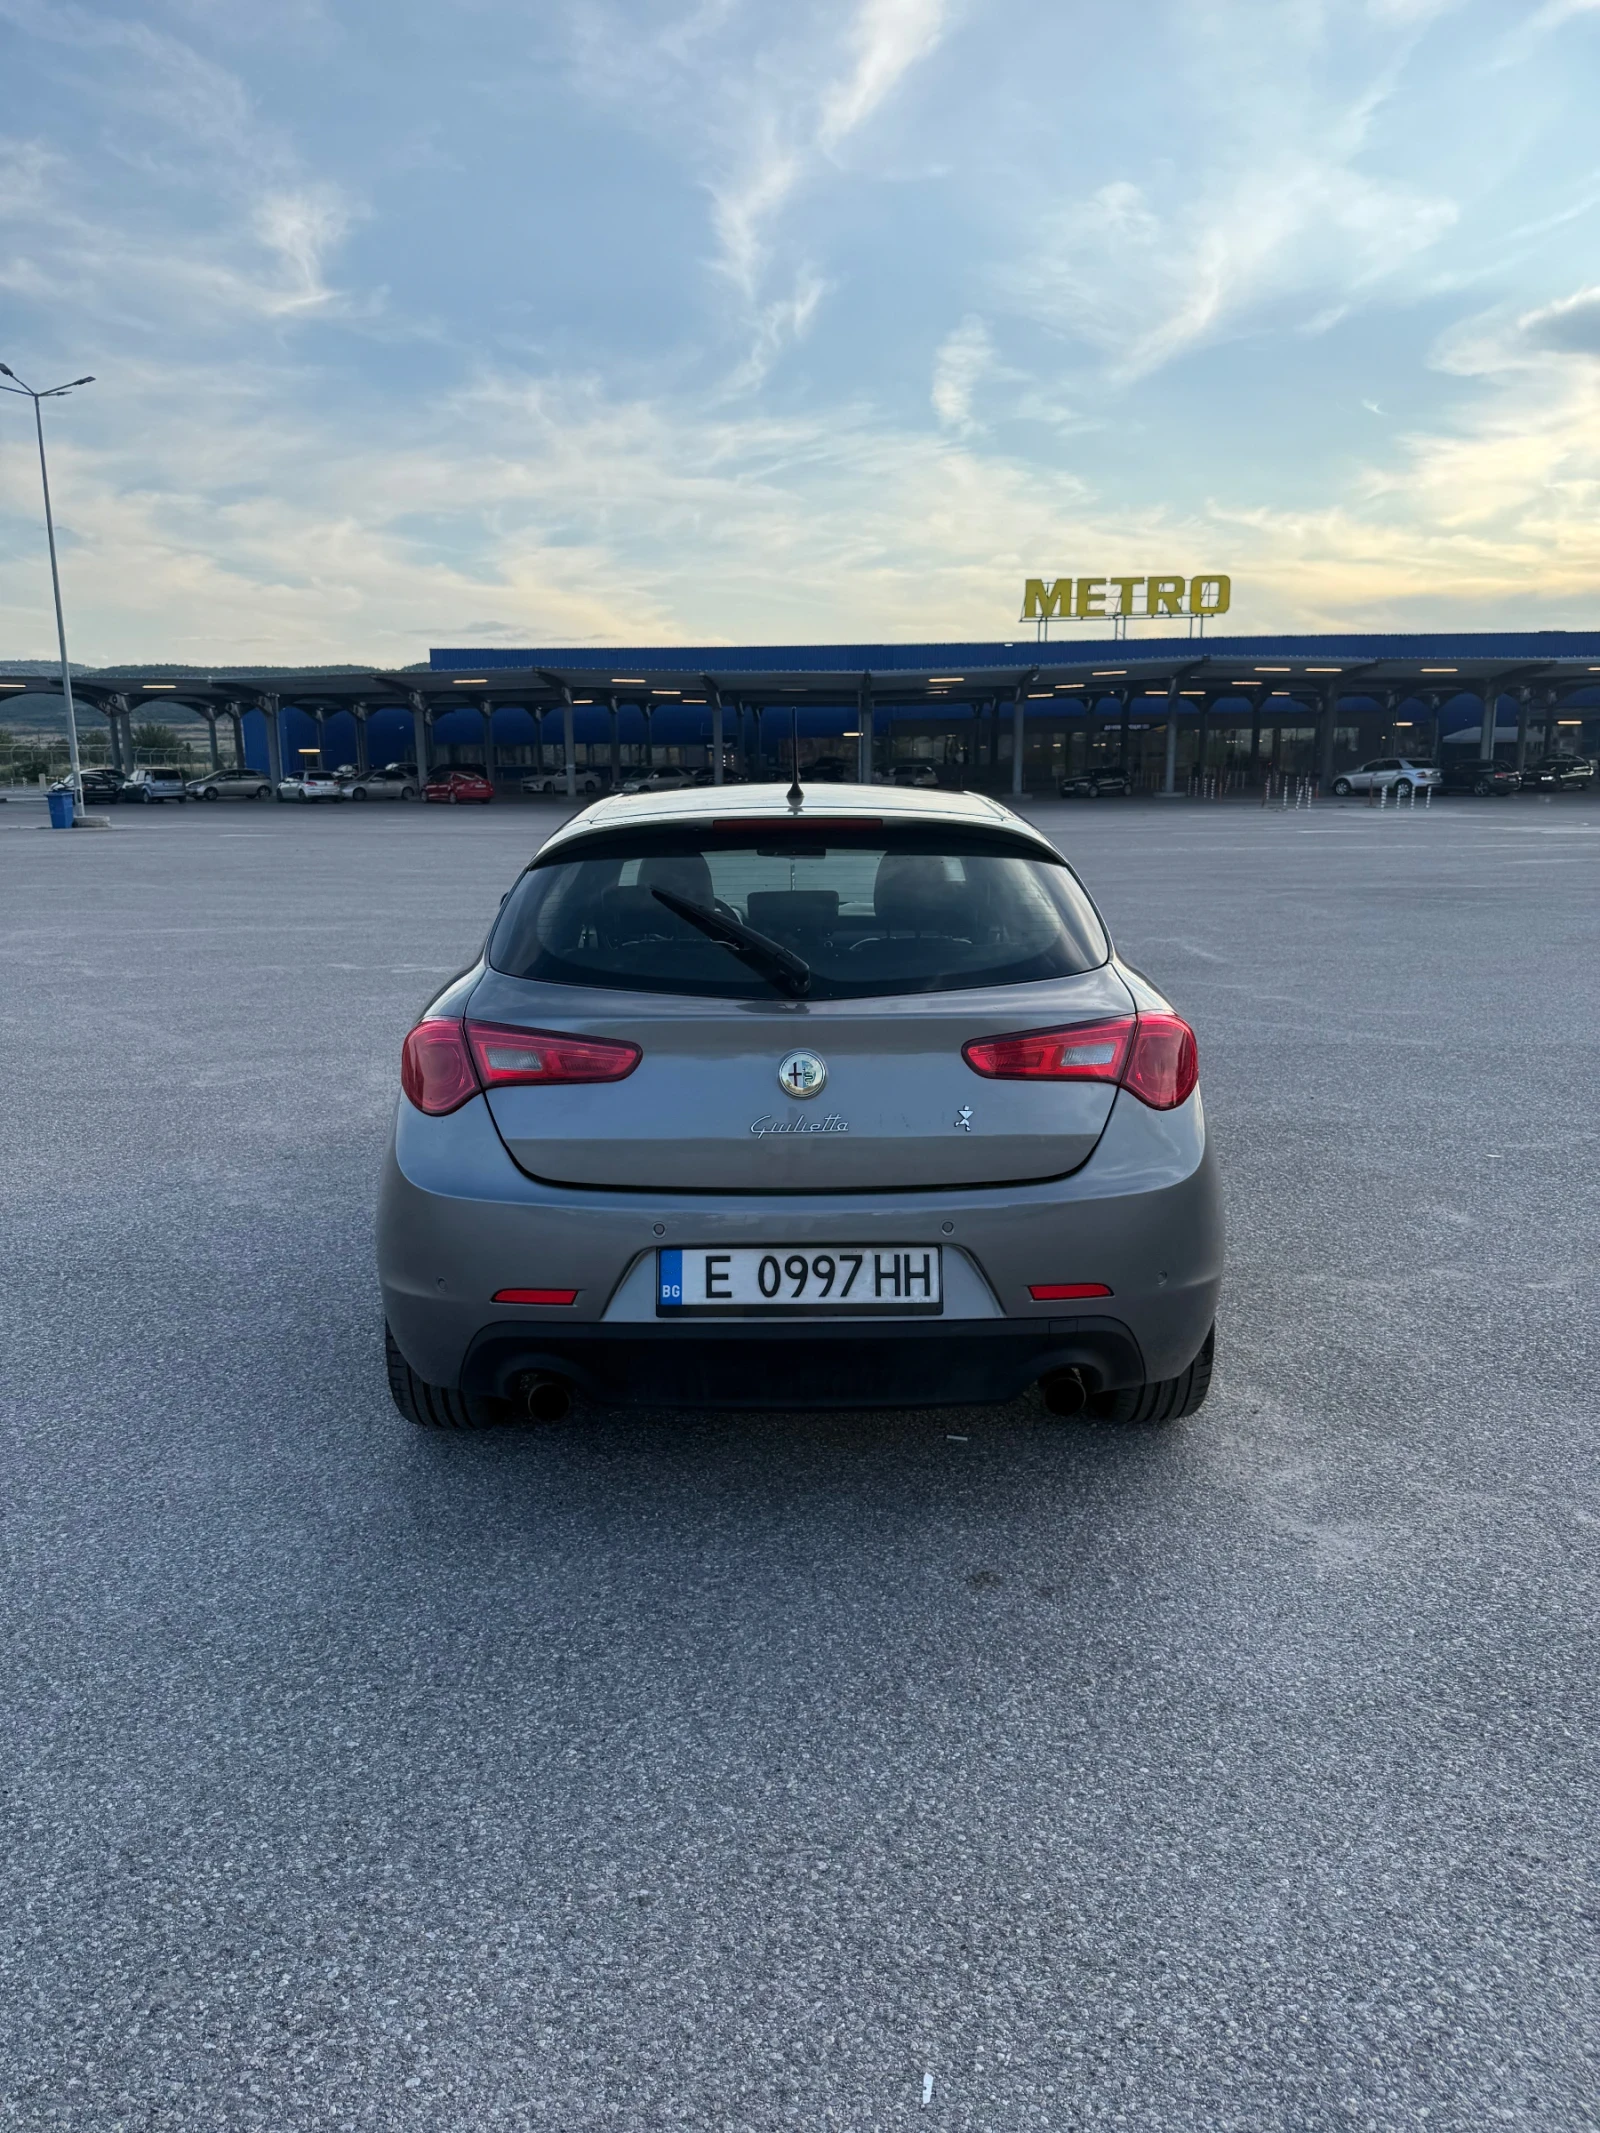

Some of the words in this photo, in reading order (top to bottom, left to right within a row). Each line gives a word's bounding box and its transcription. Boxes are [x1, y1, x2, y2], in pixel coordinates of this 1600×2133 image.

[1024, 575, 1231, 617] METRO
[750, 1114, 849, 1139] Giulietta
[662, 1284, 681, 1298] BG
[705, 1255, 733, 1299] E
